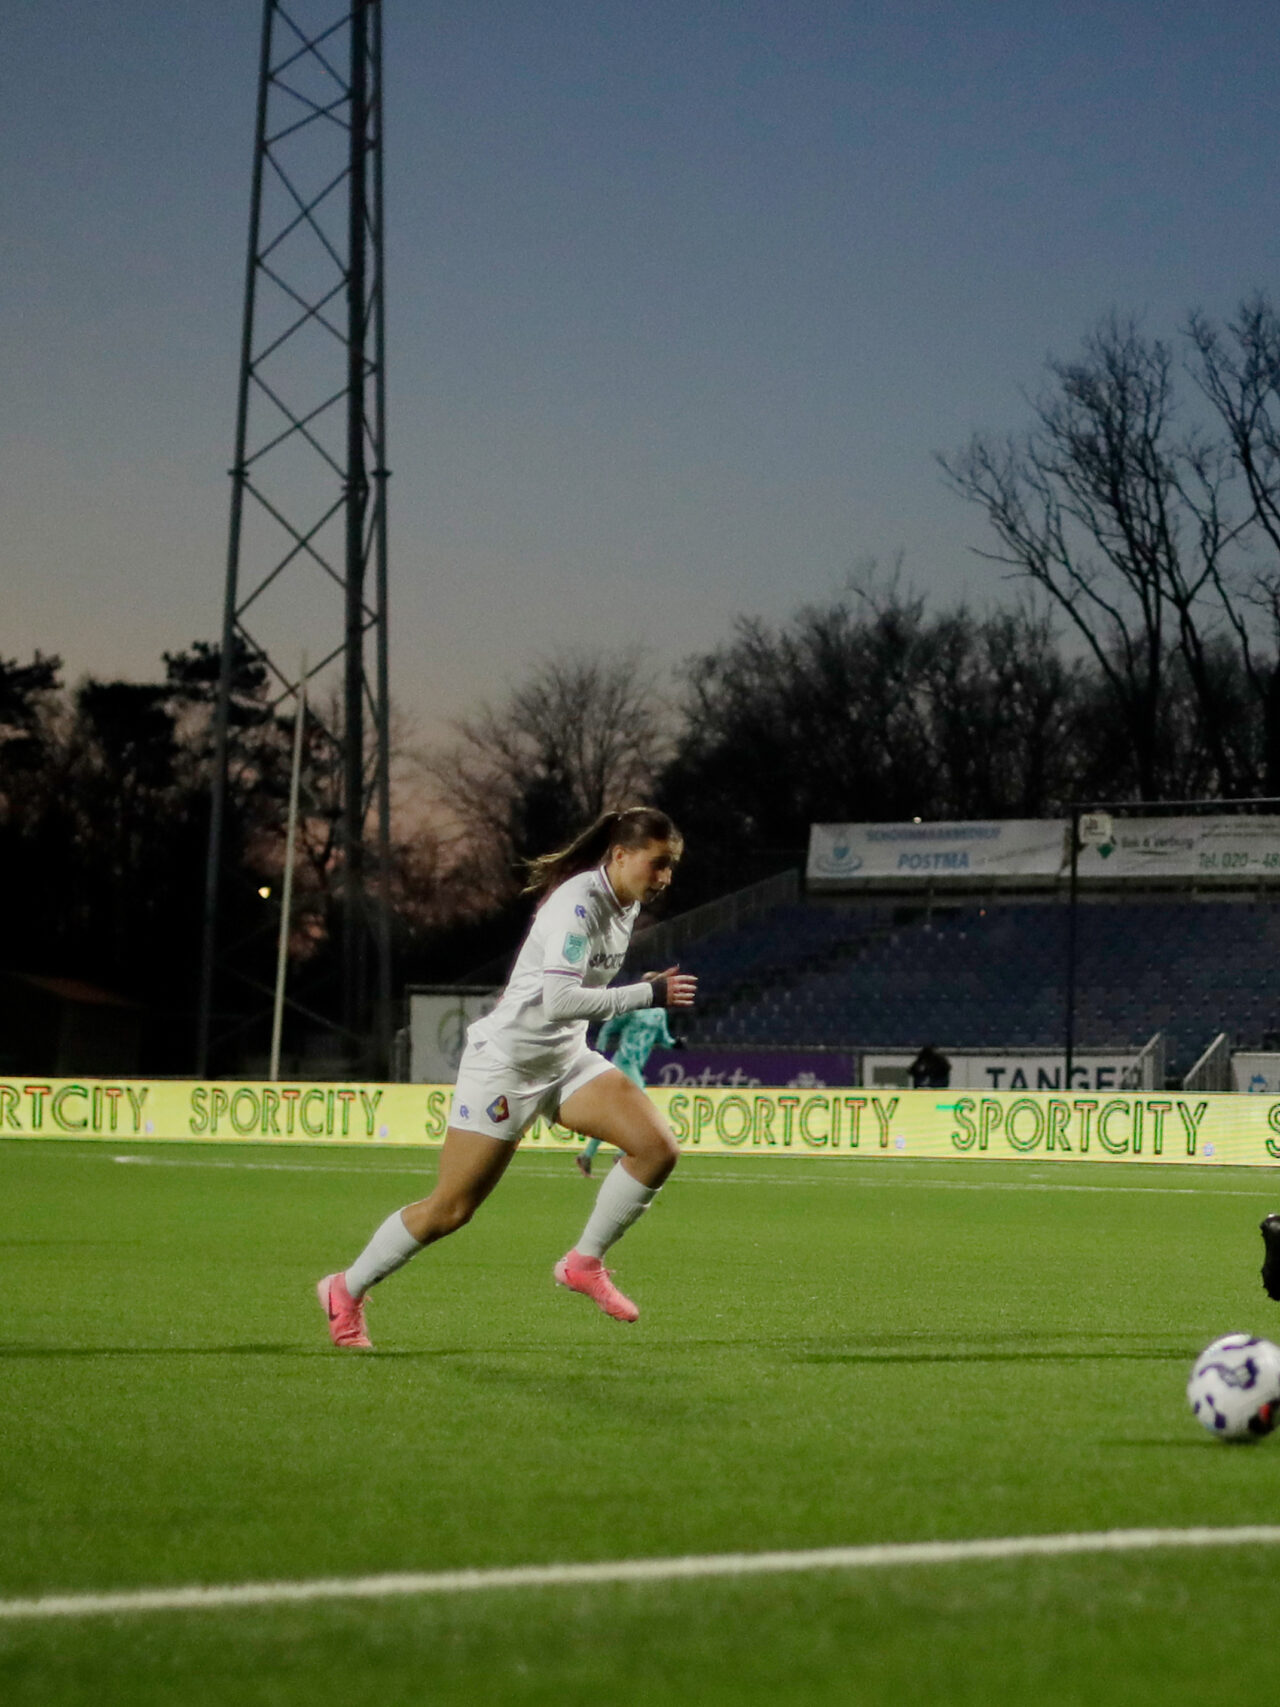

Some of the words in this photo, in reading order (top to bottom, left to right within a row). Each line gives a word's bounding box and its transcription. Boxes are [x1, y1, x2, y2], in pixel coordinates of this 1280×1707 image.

[896, 852, 969, 869] POSTMA
[190, 1086, 384, 1136] SPORTCITY
[668, 1095, 899, 1149] SPORTCITY
[952, 1098, 1208, 1157] SPORTCITY
